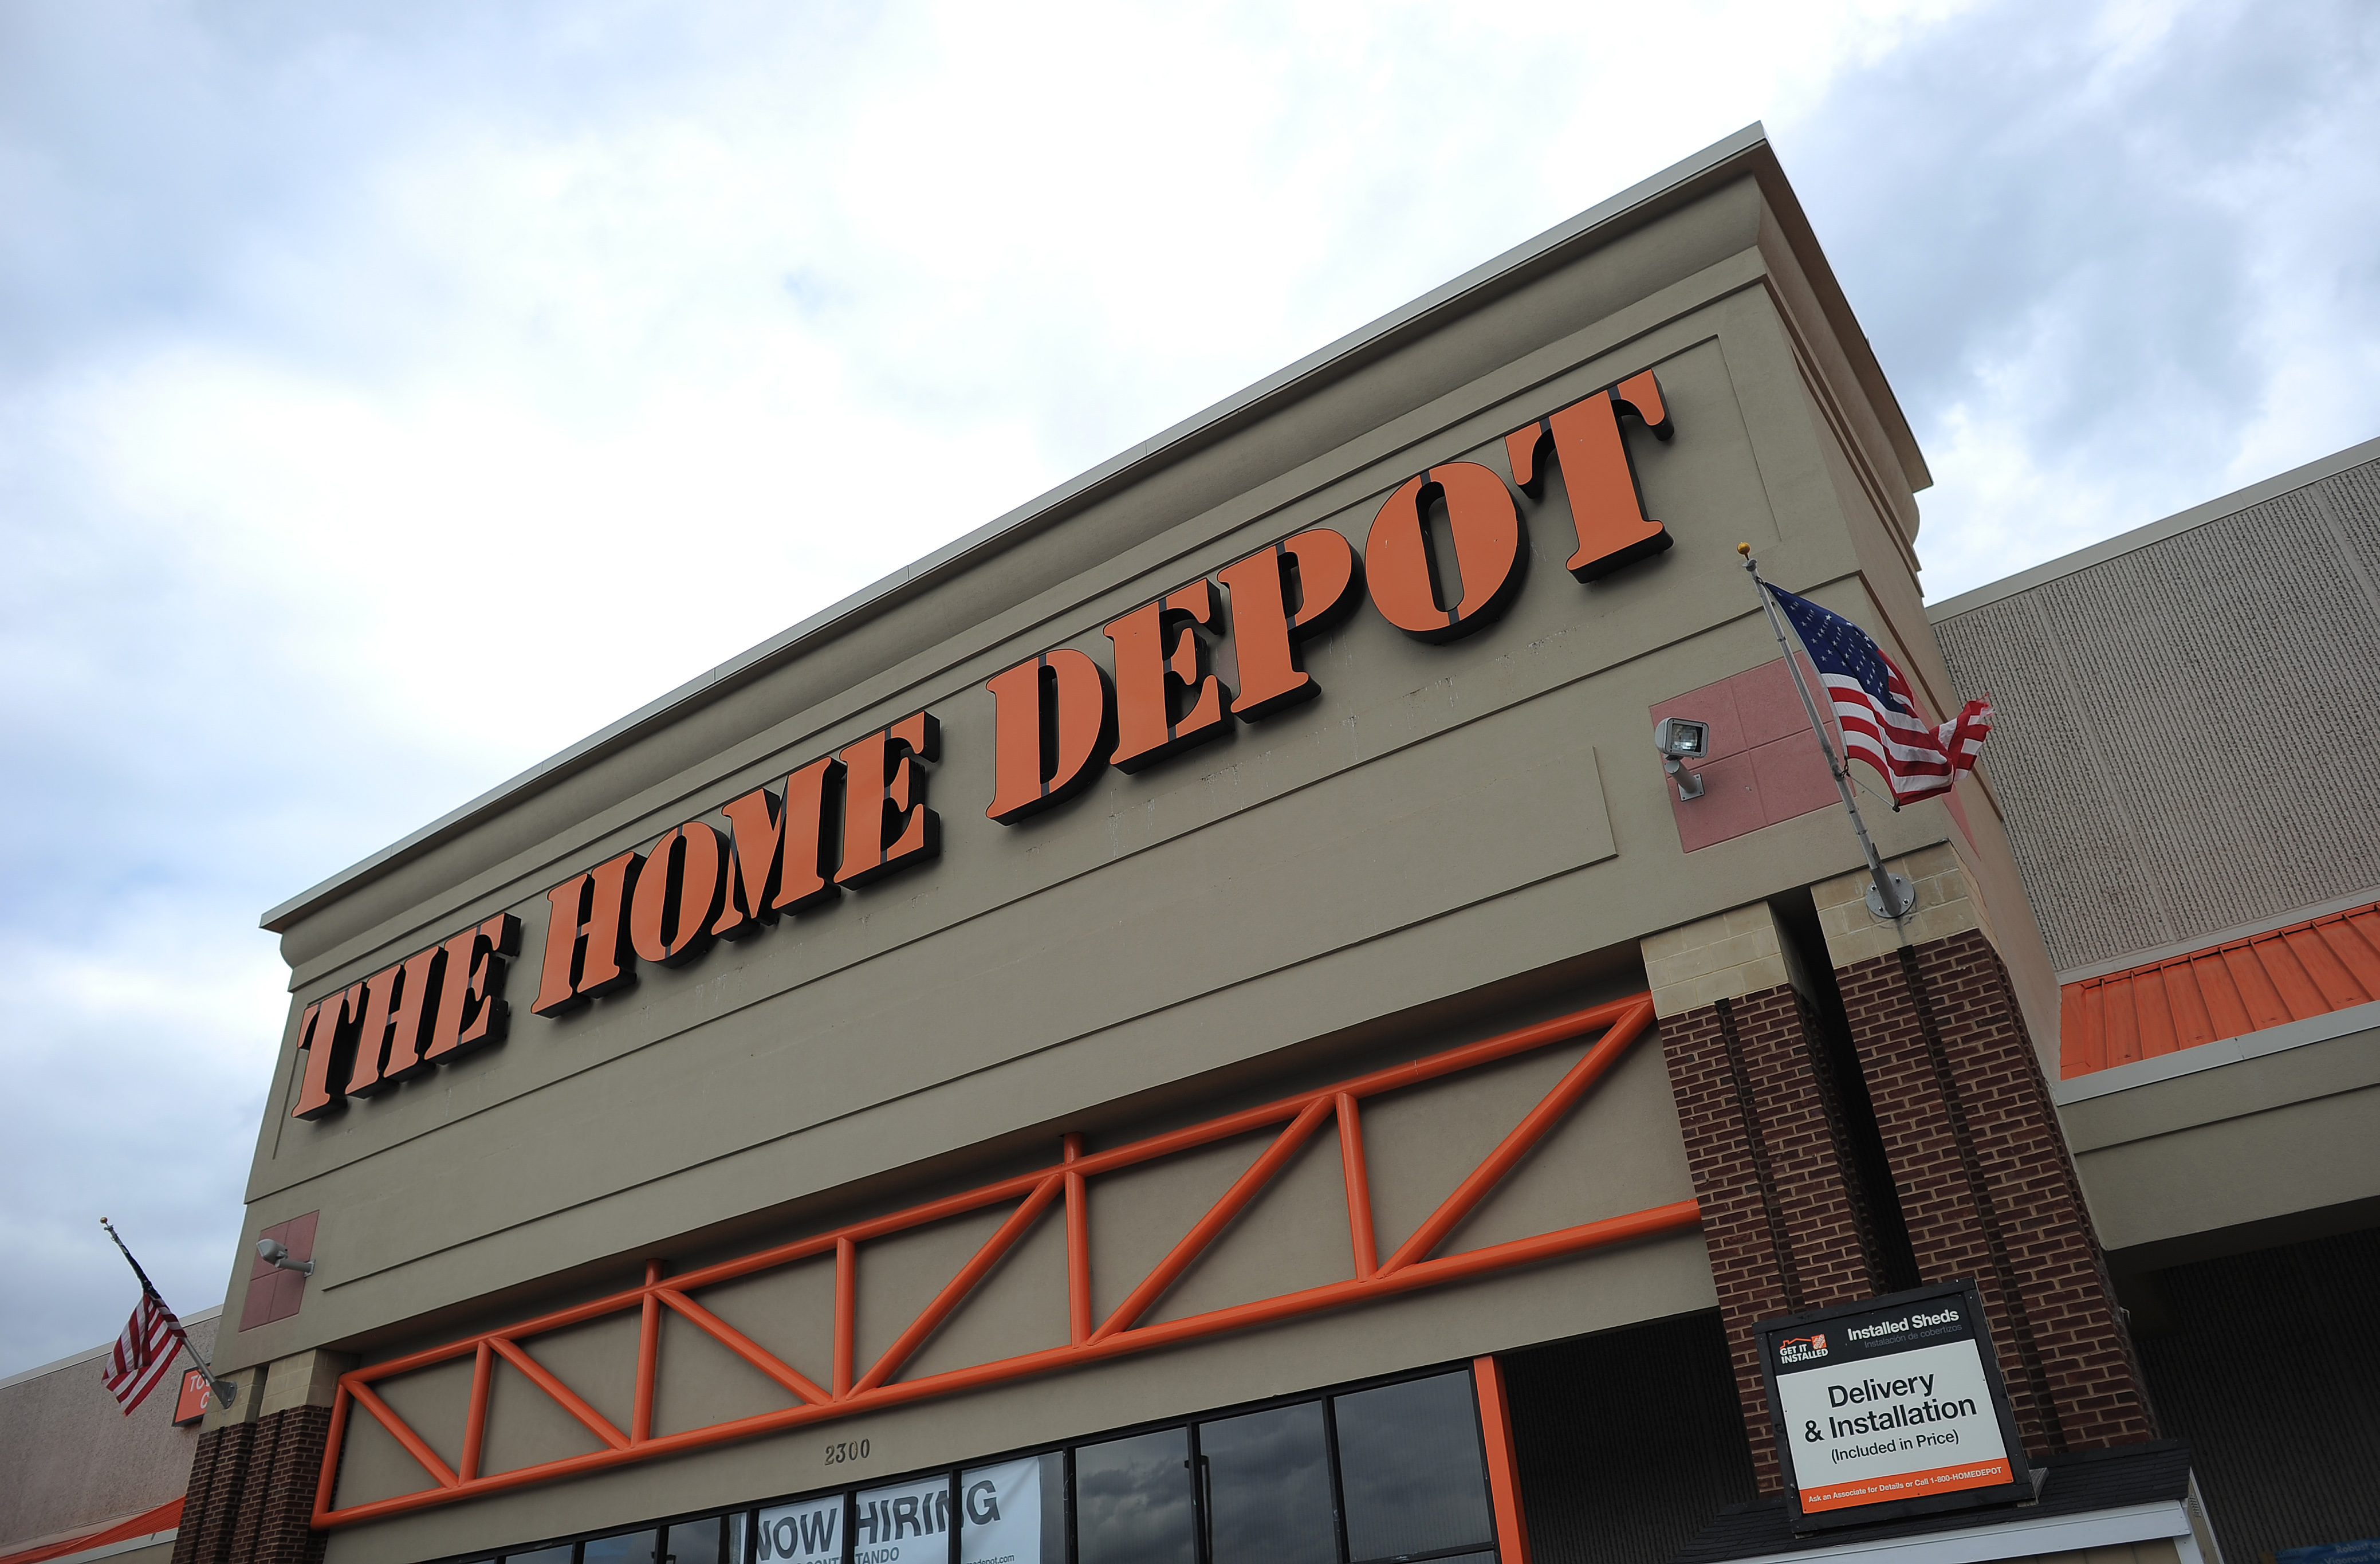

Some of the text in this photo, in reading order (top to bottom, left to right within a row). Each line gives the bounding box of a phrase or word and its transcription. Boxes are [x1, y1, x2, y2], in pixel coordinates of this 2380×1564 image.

[291, 368, 1674, 1121] THE HOME DEPOT
[1847, 1309, 1959, 1341] Installed Sheds
[1864, 1325, 1962, 1349] Instalación de cobertizos
[1780, 1344, 1807, 1355] GET IT
[1781, 1349, 1828, 1363] INSTALLED
[1828, 1374, 1934, 1408] Delivery
[1805, 1398, 1977, 1443] & Installation
[824, 1439, 870, 1465] 2300
[1831, 1429, 1959, 1464] (Included in Price)
[1808, 1495, 1822, 1503] Ask
[1833, 1488, 1867, 1499] Associate
[1868, 1486, 1878, 1494] for
[1879, 1482, 1904, 1492] Details
[1915, 1478, 1929, 1487] Call
[1930, 1467, 2002, 1484] 1-800-HOMEDEPOT
[2335, 1543, 2369, 1554] Robust
